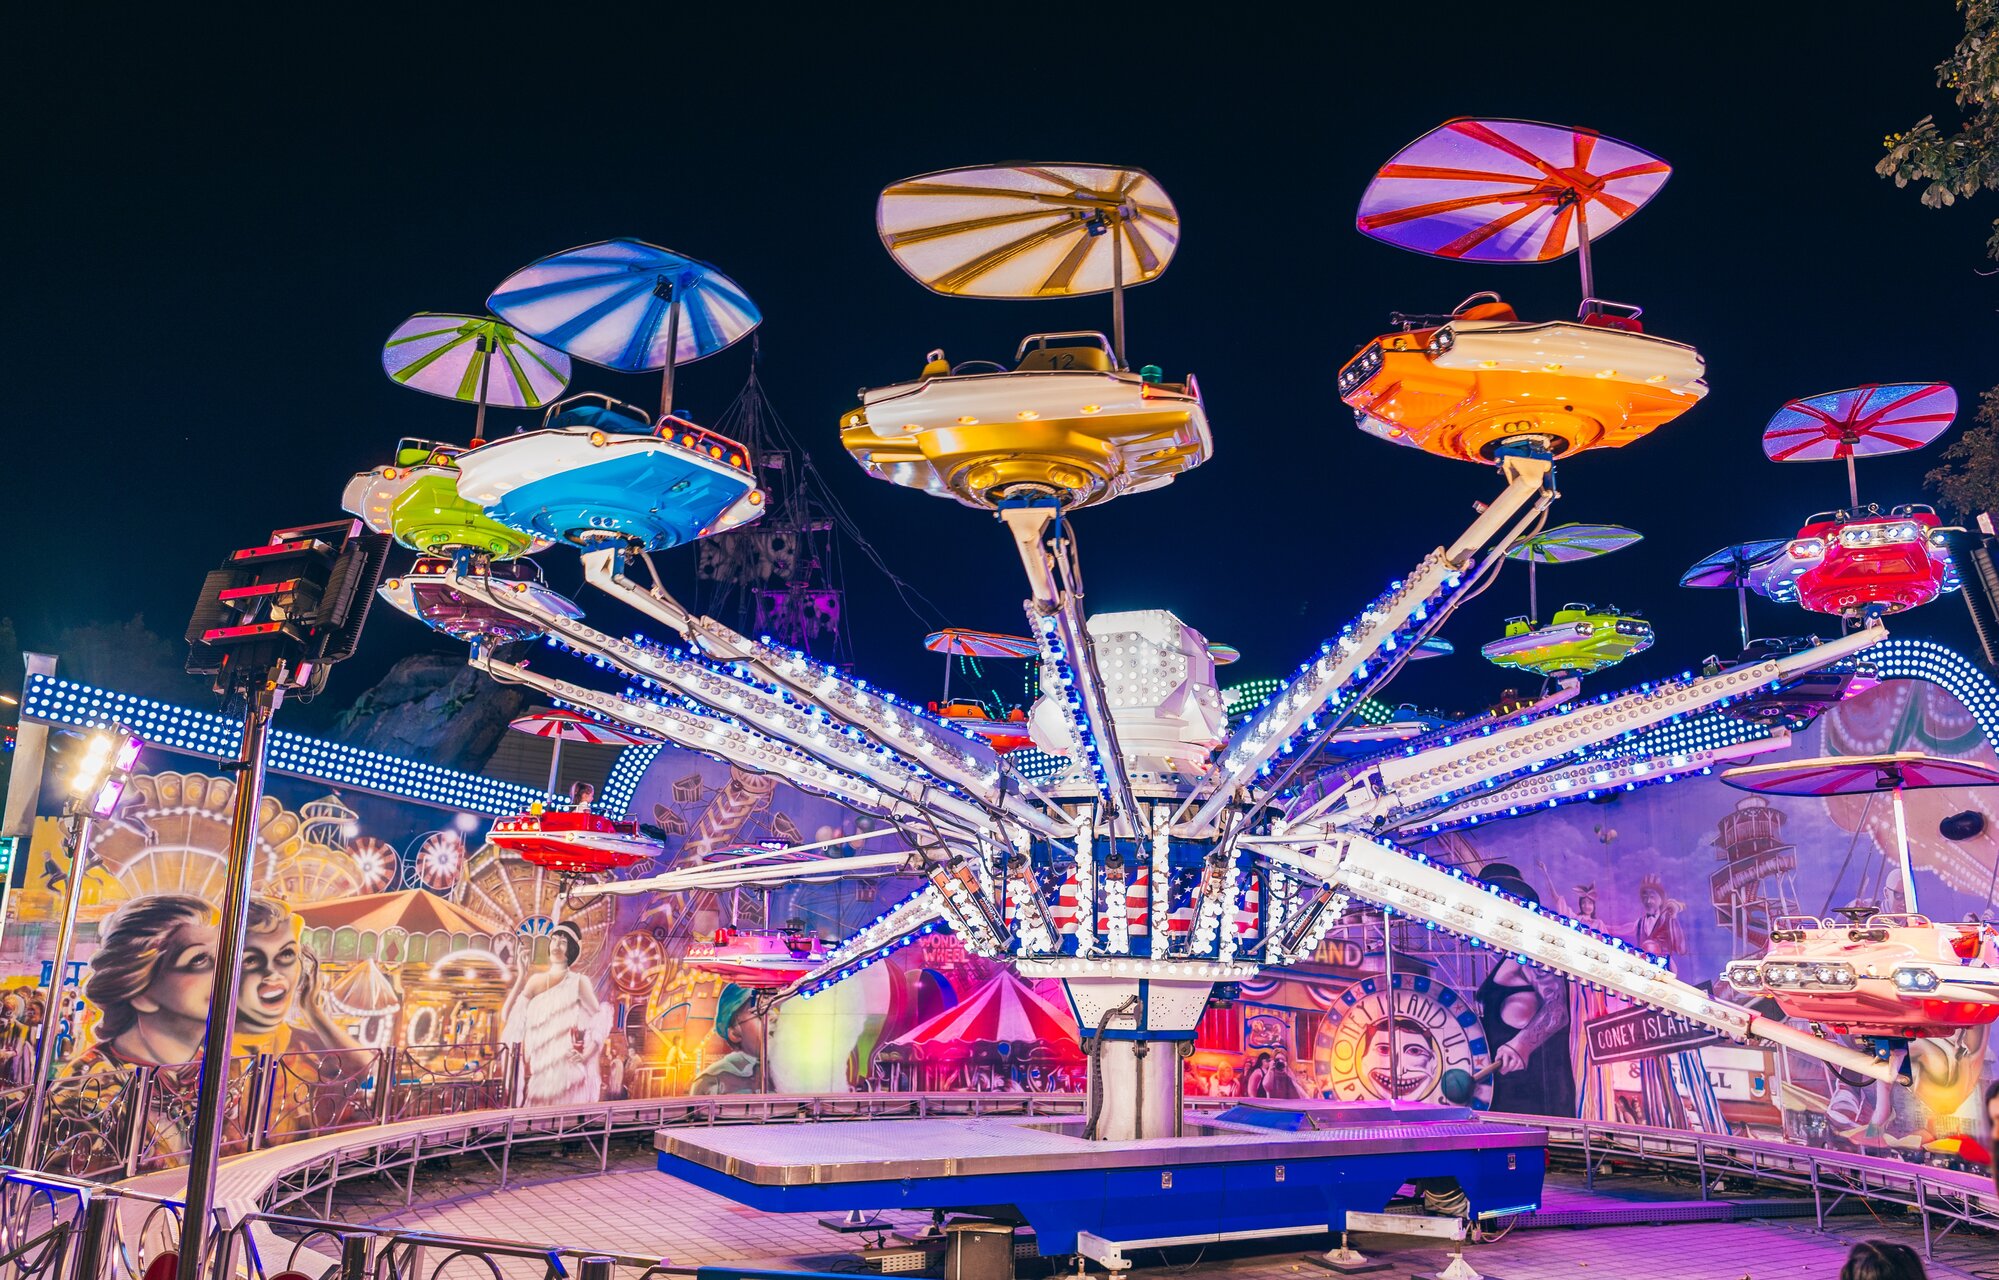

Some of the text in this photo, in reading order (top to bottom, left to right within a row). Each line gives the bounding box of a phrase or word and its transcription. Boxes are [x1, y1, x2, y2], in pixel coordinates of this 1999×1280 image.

[1049, 352, 1075, 370] 12
[923, 948, 969, 963] WHEEL
[1334, 1001, 1373, 1075] CONEY
[1376, 992, 1448, 1029] ILAND
[1597, 1015, 1699, 1049] CONEY ISLAN
